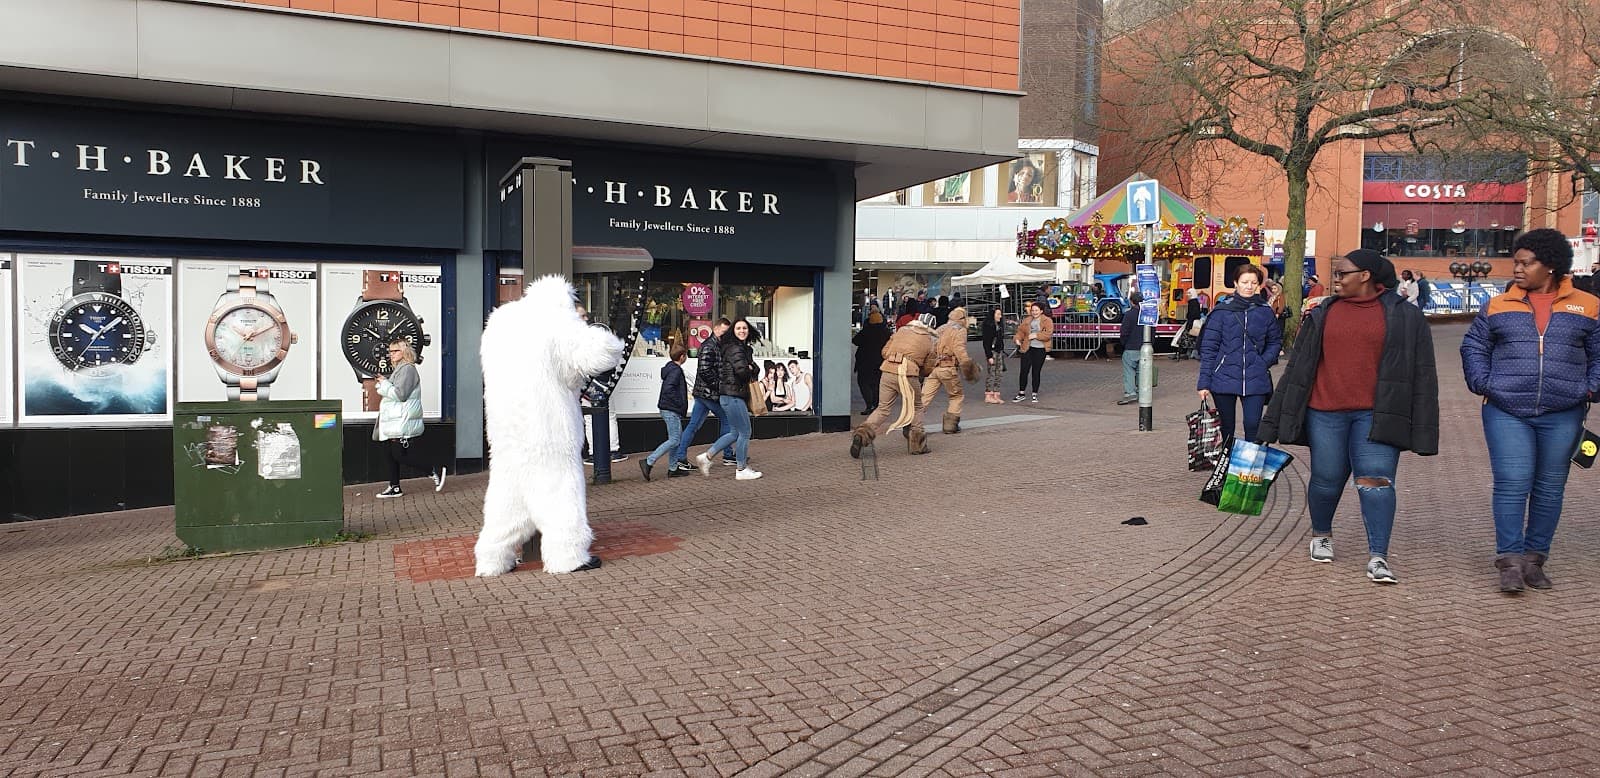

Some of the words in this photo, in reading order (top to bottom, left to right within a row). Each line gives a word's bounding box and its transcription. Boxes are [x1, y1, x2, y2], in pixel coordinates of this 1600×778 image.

[147, 149, 326, 185] BAKER
[1404, 184, 1466, 199] COSTA
[83, 188, 129, 204] Family
[131, 191, 190, 205] Jewellers
[193, 194, 227, 207] Since
[231, 197, 262, 208] 1888
[653, 184, 782, 215] BAKER
[609, 217, 642, 232] Family
[643, 220, 684, 232] Jewellers
[686, 223, 711, 234] Since
[713, 225, 736, 235] 1888
[121, 265, 168, 275] TISSOT
[270, 270, 312, 279] TISSOT
[400, 274, 440, 283] TISSOT
[690, 286, 706, 295] 0%
[376, 310, 389, 320] 12
[352, 335, 361, 344] 9
[379, 360, 388, 369] 6
